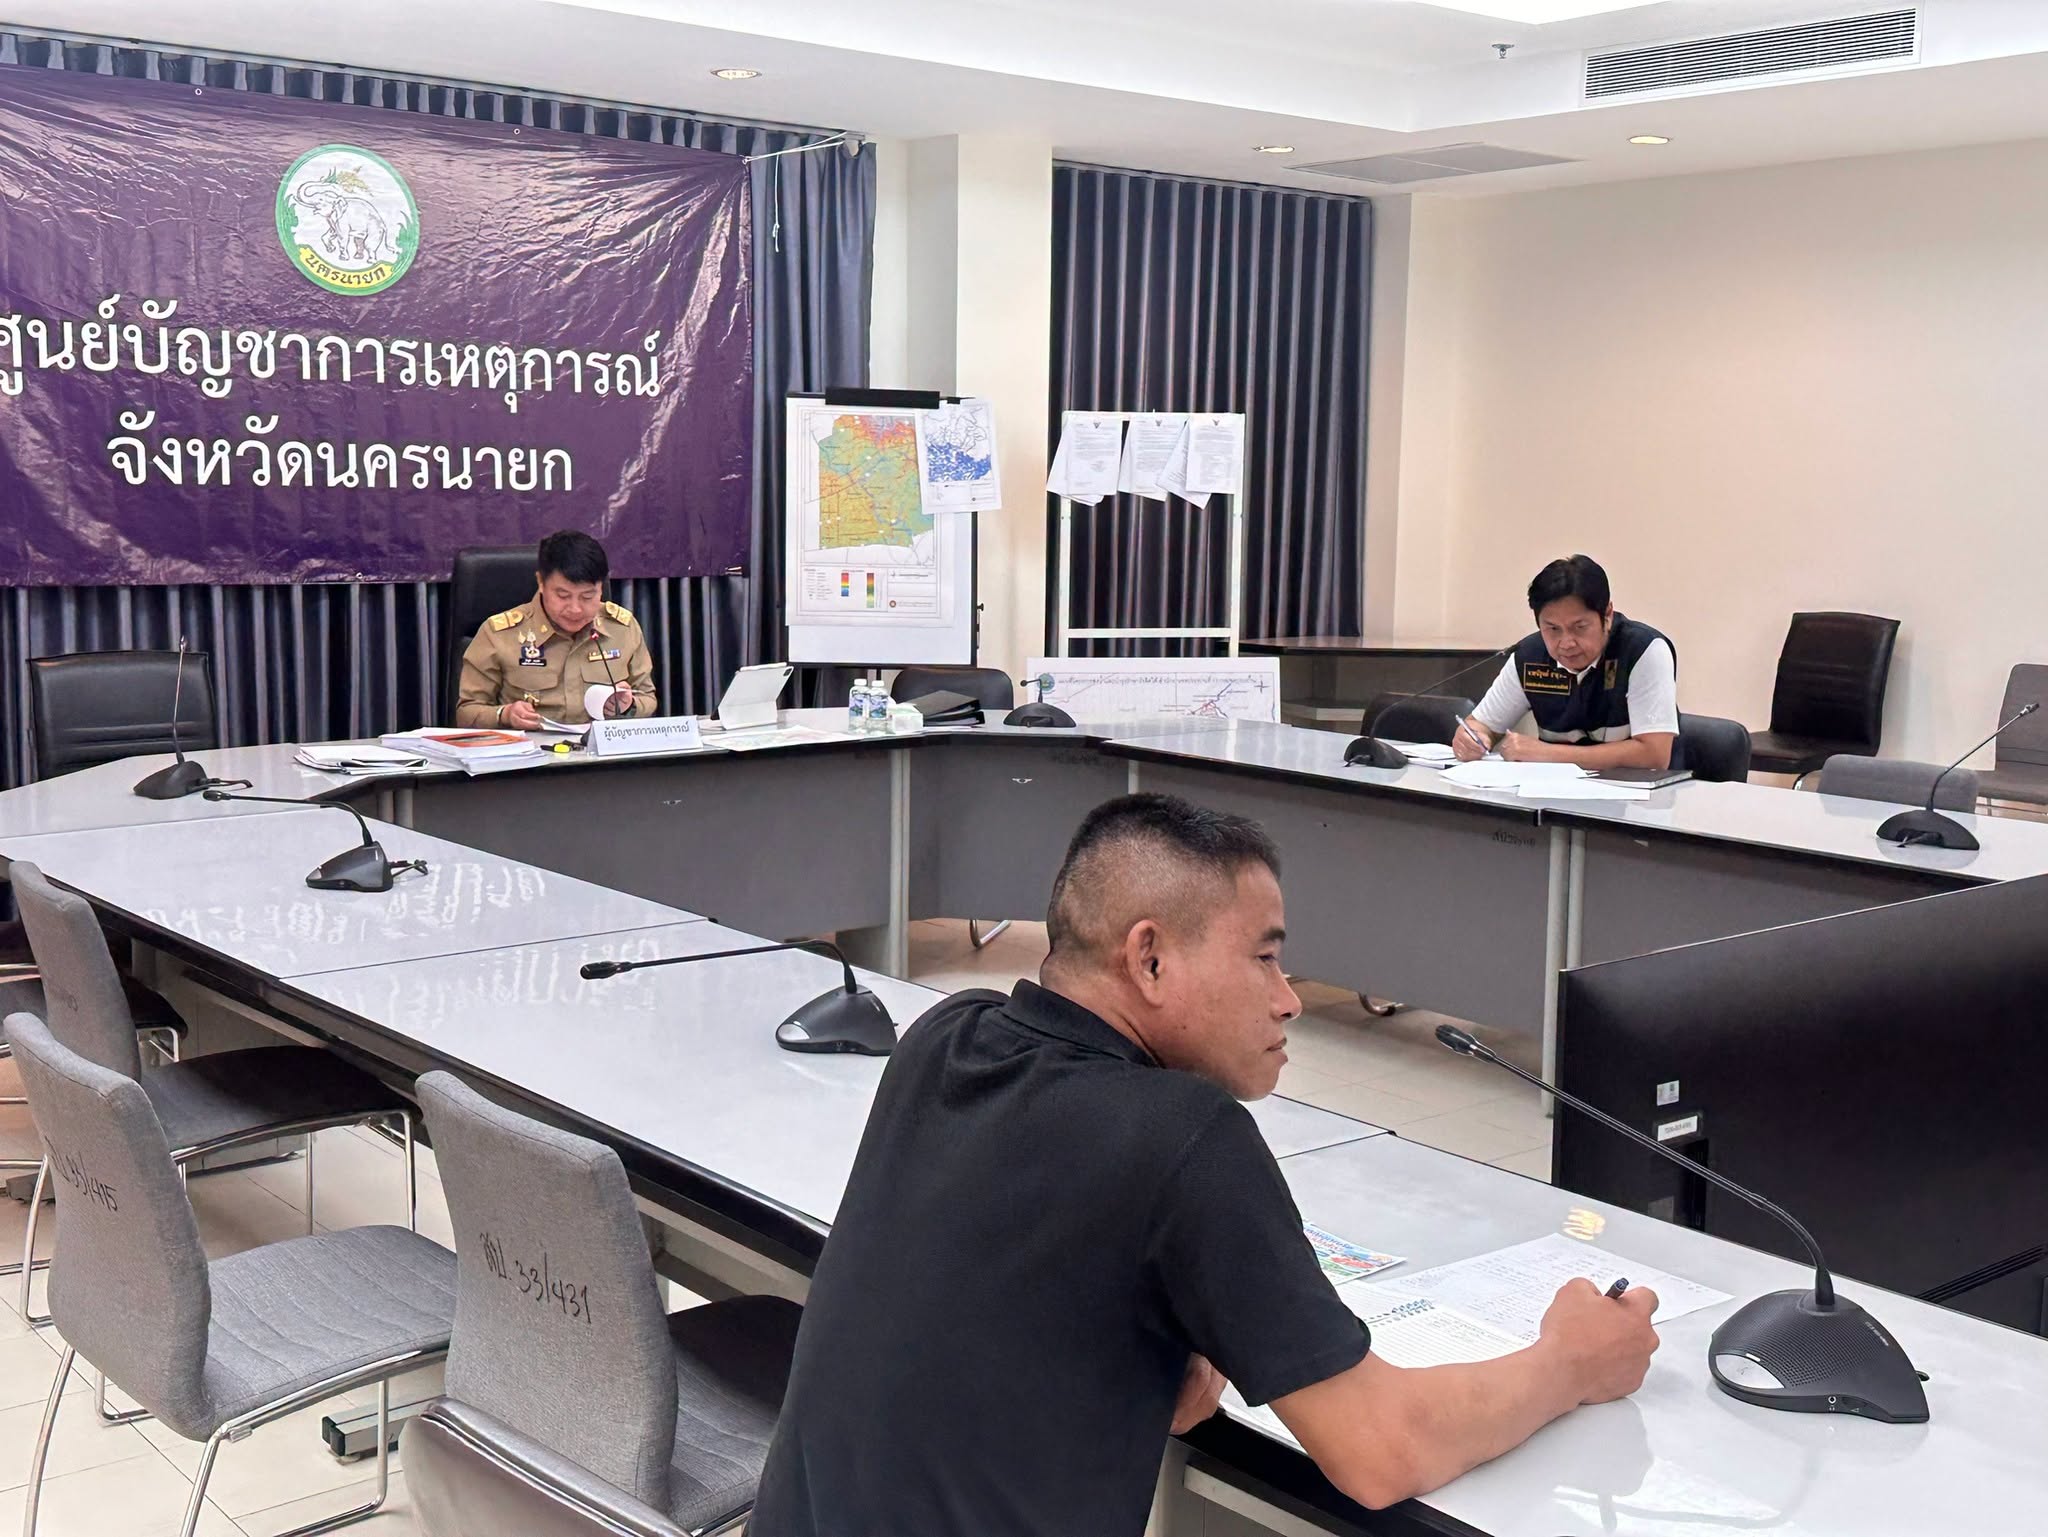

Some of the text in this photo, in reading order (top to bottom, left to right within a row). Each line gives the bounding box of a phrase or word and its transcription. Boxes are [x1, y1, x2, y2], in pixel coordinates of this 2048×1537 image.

[106, 410, 573, 491] จังหวัดนครนายก
[515, 1251, 592, 1325] 33/431
